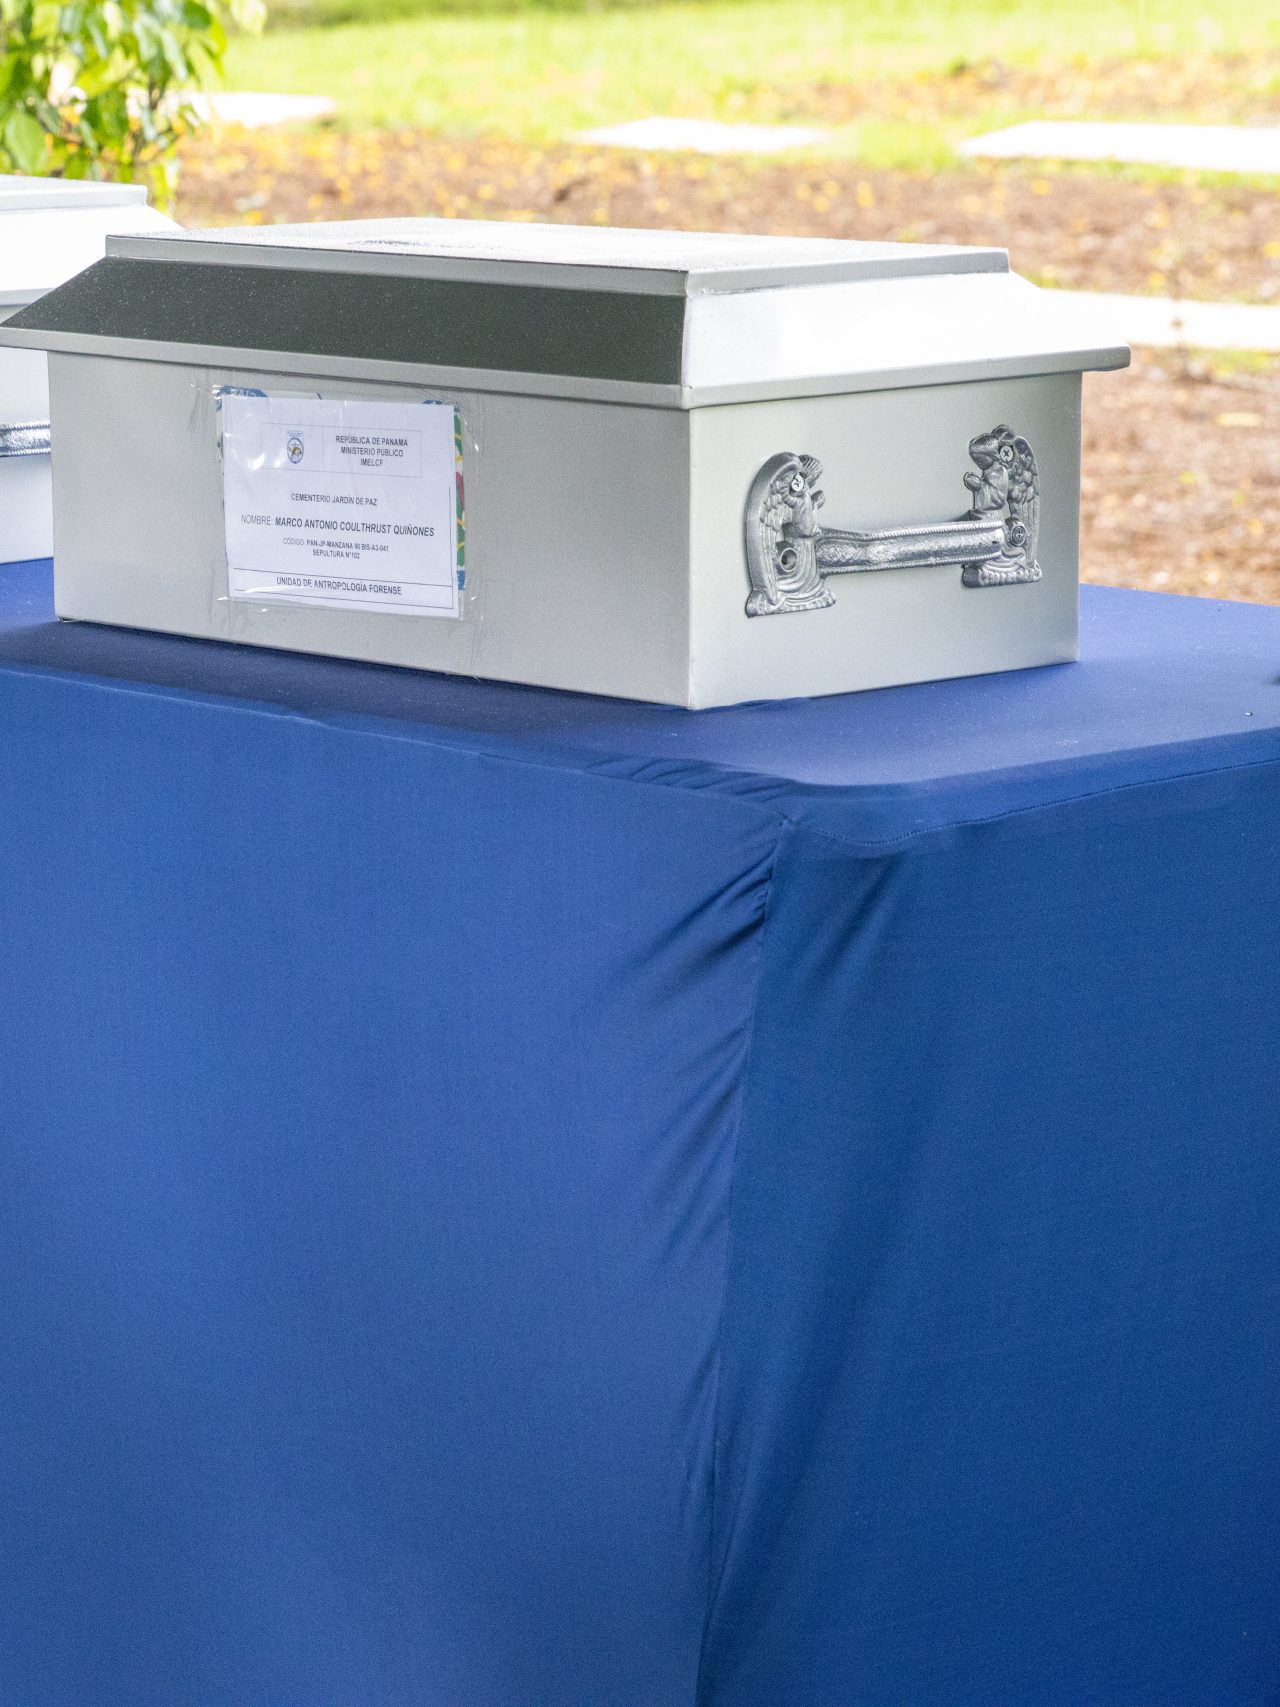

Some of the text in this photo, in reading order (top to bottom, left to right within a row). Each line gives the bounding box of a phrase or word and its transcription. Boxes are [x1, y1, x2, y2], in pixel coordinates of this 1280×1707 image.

[372, 437, 380, 445] DE
[341, 446, 375, 456] MINISTERIO
[361, 458, 383, 467] IMELCF
[291, 493, 377, 506] CEMENTERIO JARDÍN DE PAZ
[275, 516, 302, 528] MARCO
[304, 518, 338, 530] ANTONIO
[340, 521, 391, 534] COULTHRUST
[393, 523, 435, 537] QUIÑONES
[312, 548, 344, 558] SEPULTURA
[276, 576, 402, 595] UNIDAD DE ANTROPOLOGÍA FORENSE
